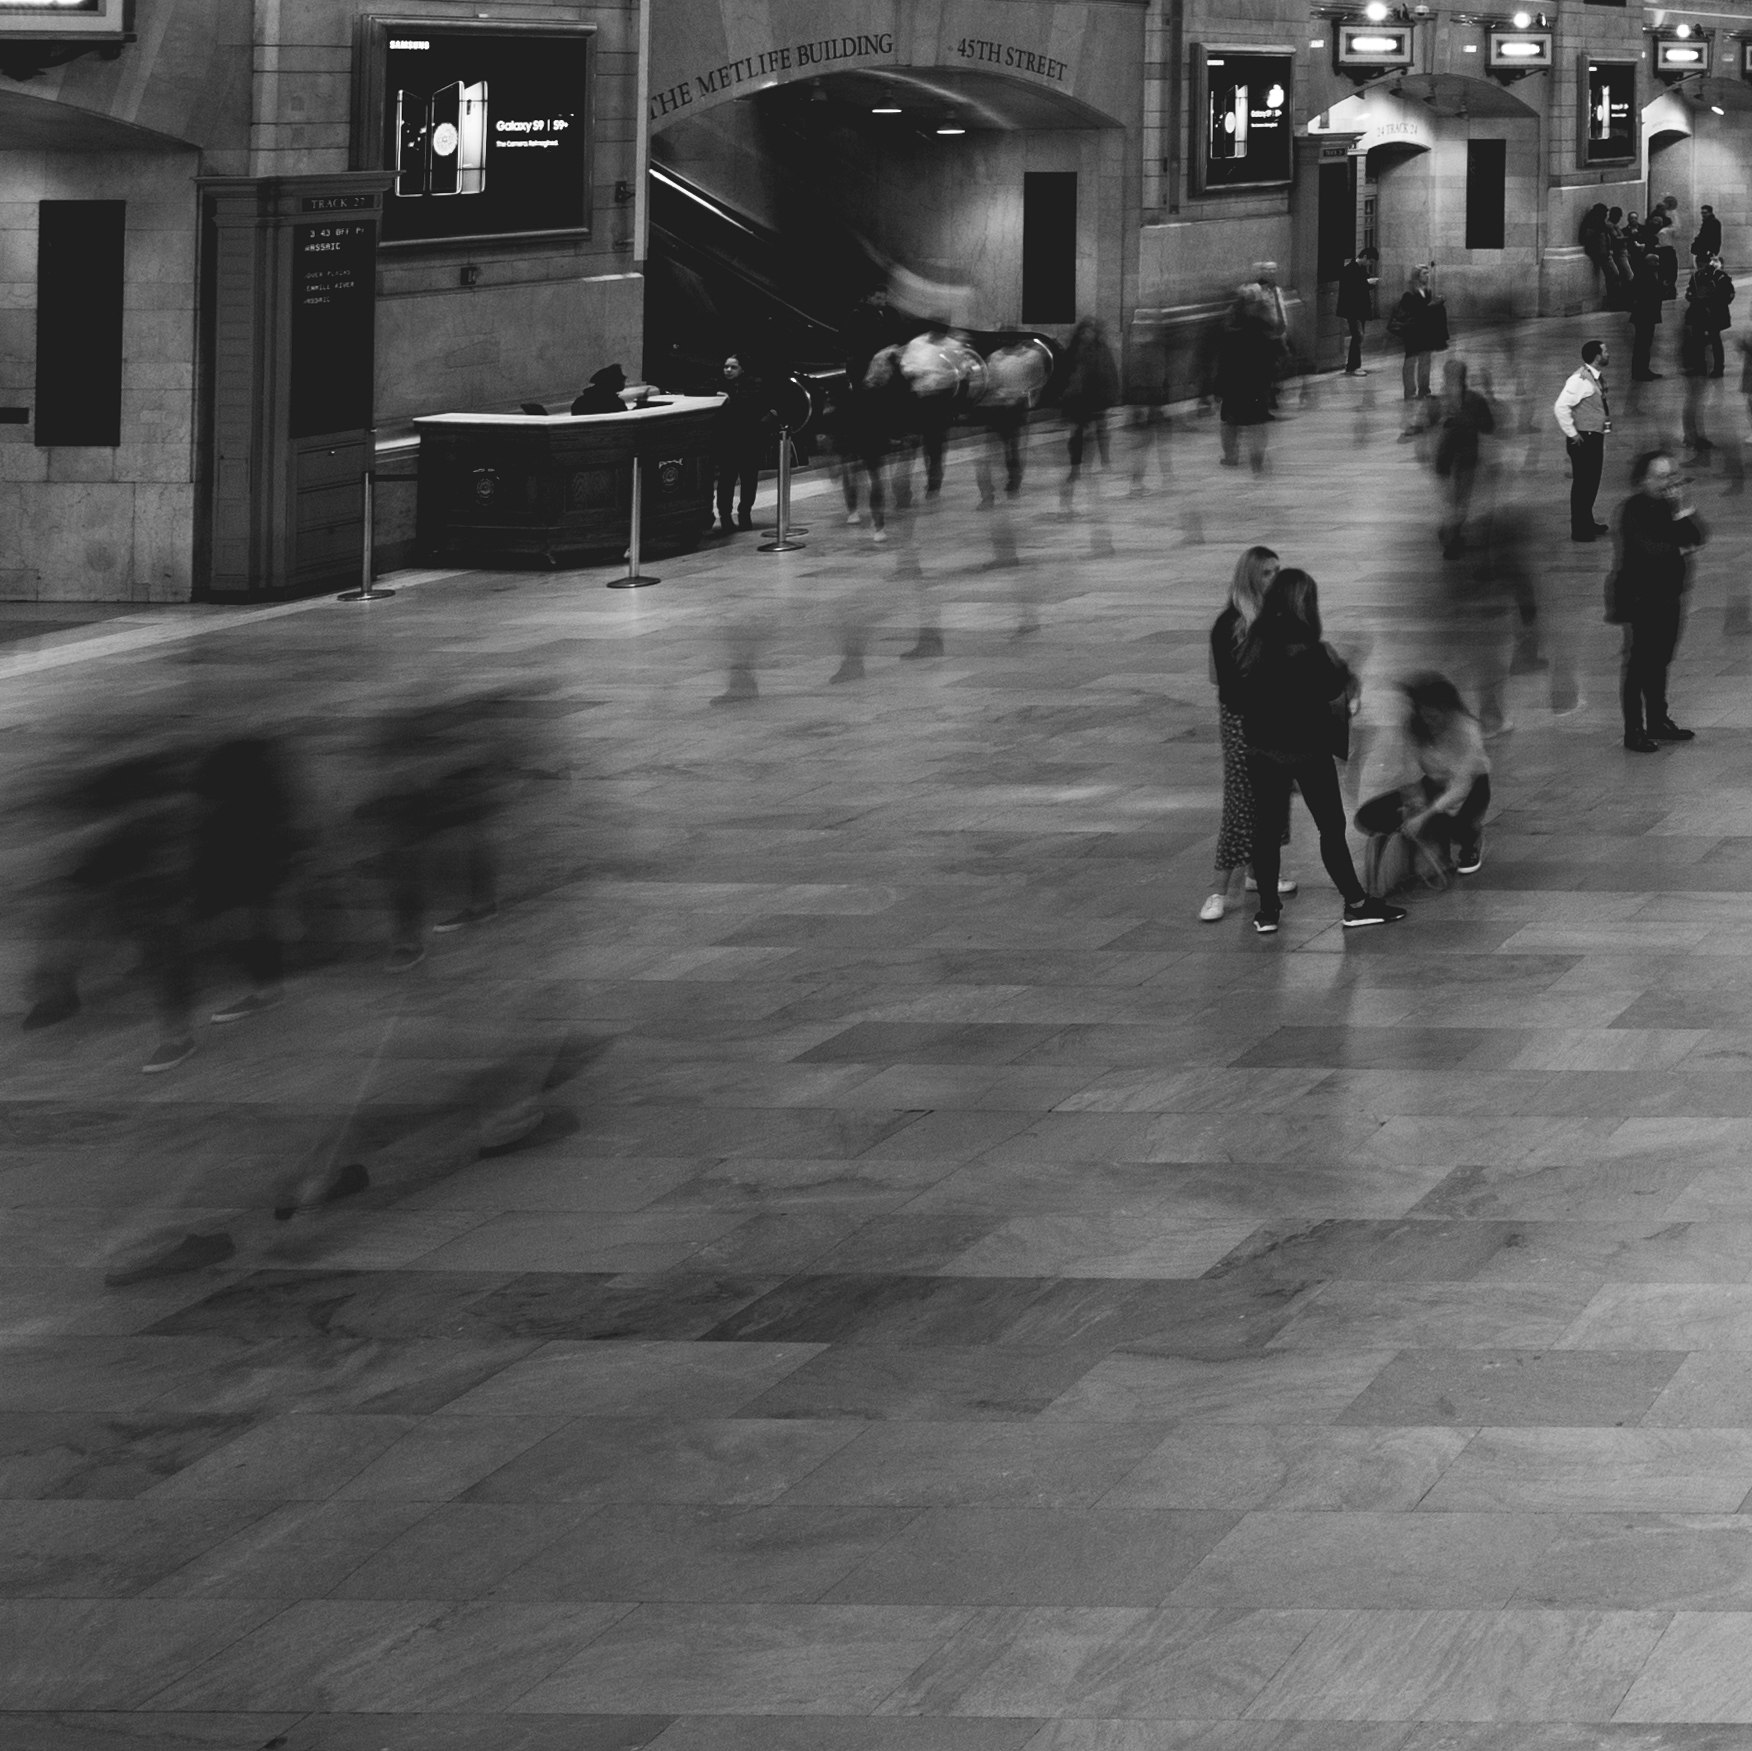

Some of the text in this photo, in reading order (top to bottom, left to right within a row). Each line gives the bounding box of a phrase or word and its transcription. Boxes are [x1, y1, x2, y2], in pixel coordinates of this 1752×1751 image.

[957, 38, 1068, 81] 45TH STREET
[649, 32, 894, 121] THE METLIFE BUILDING
[496, 121, 532, 132] Galaxy
[311, 199, 348, 209] TRACK
